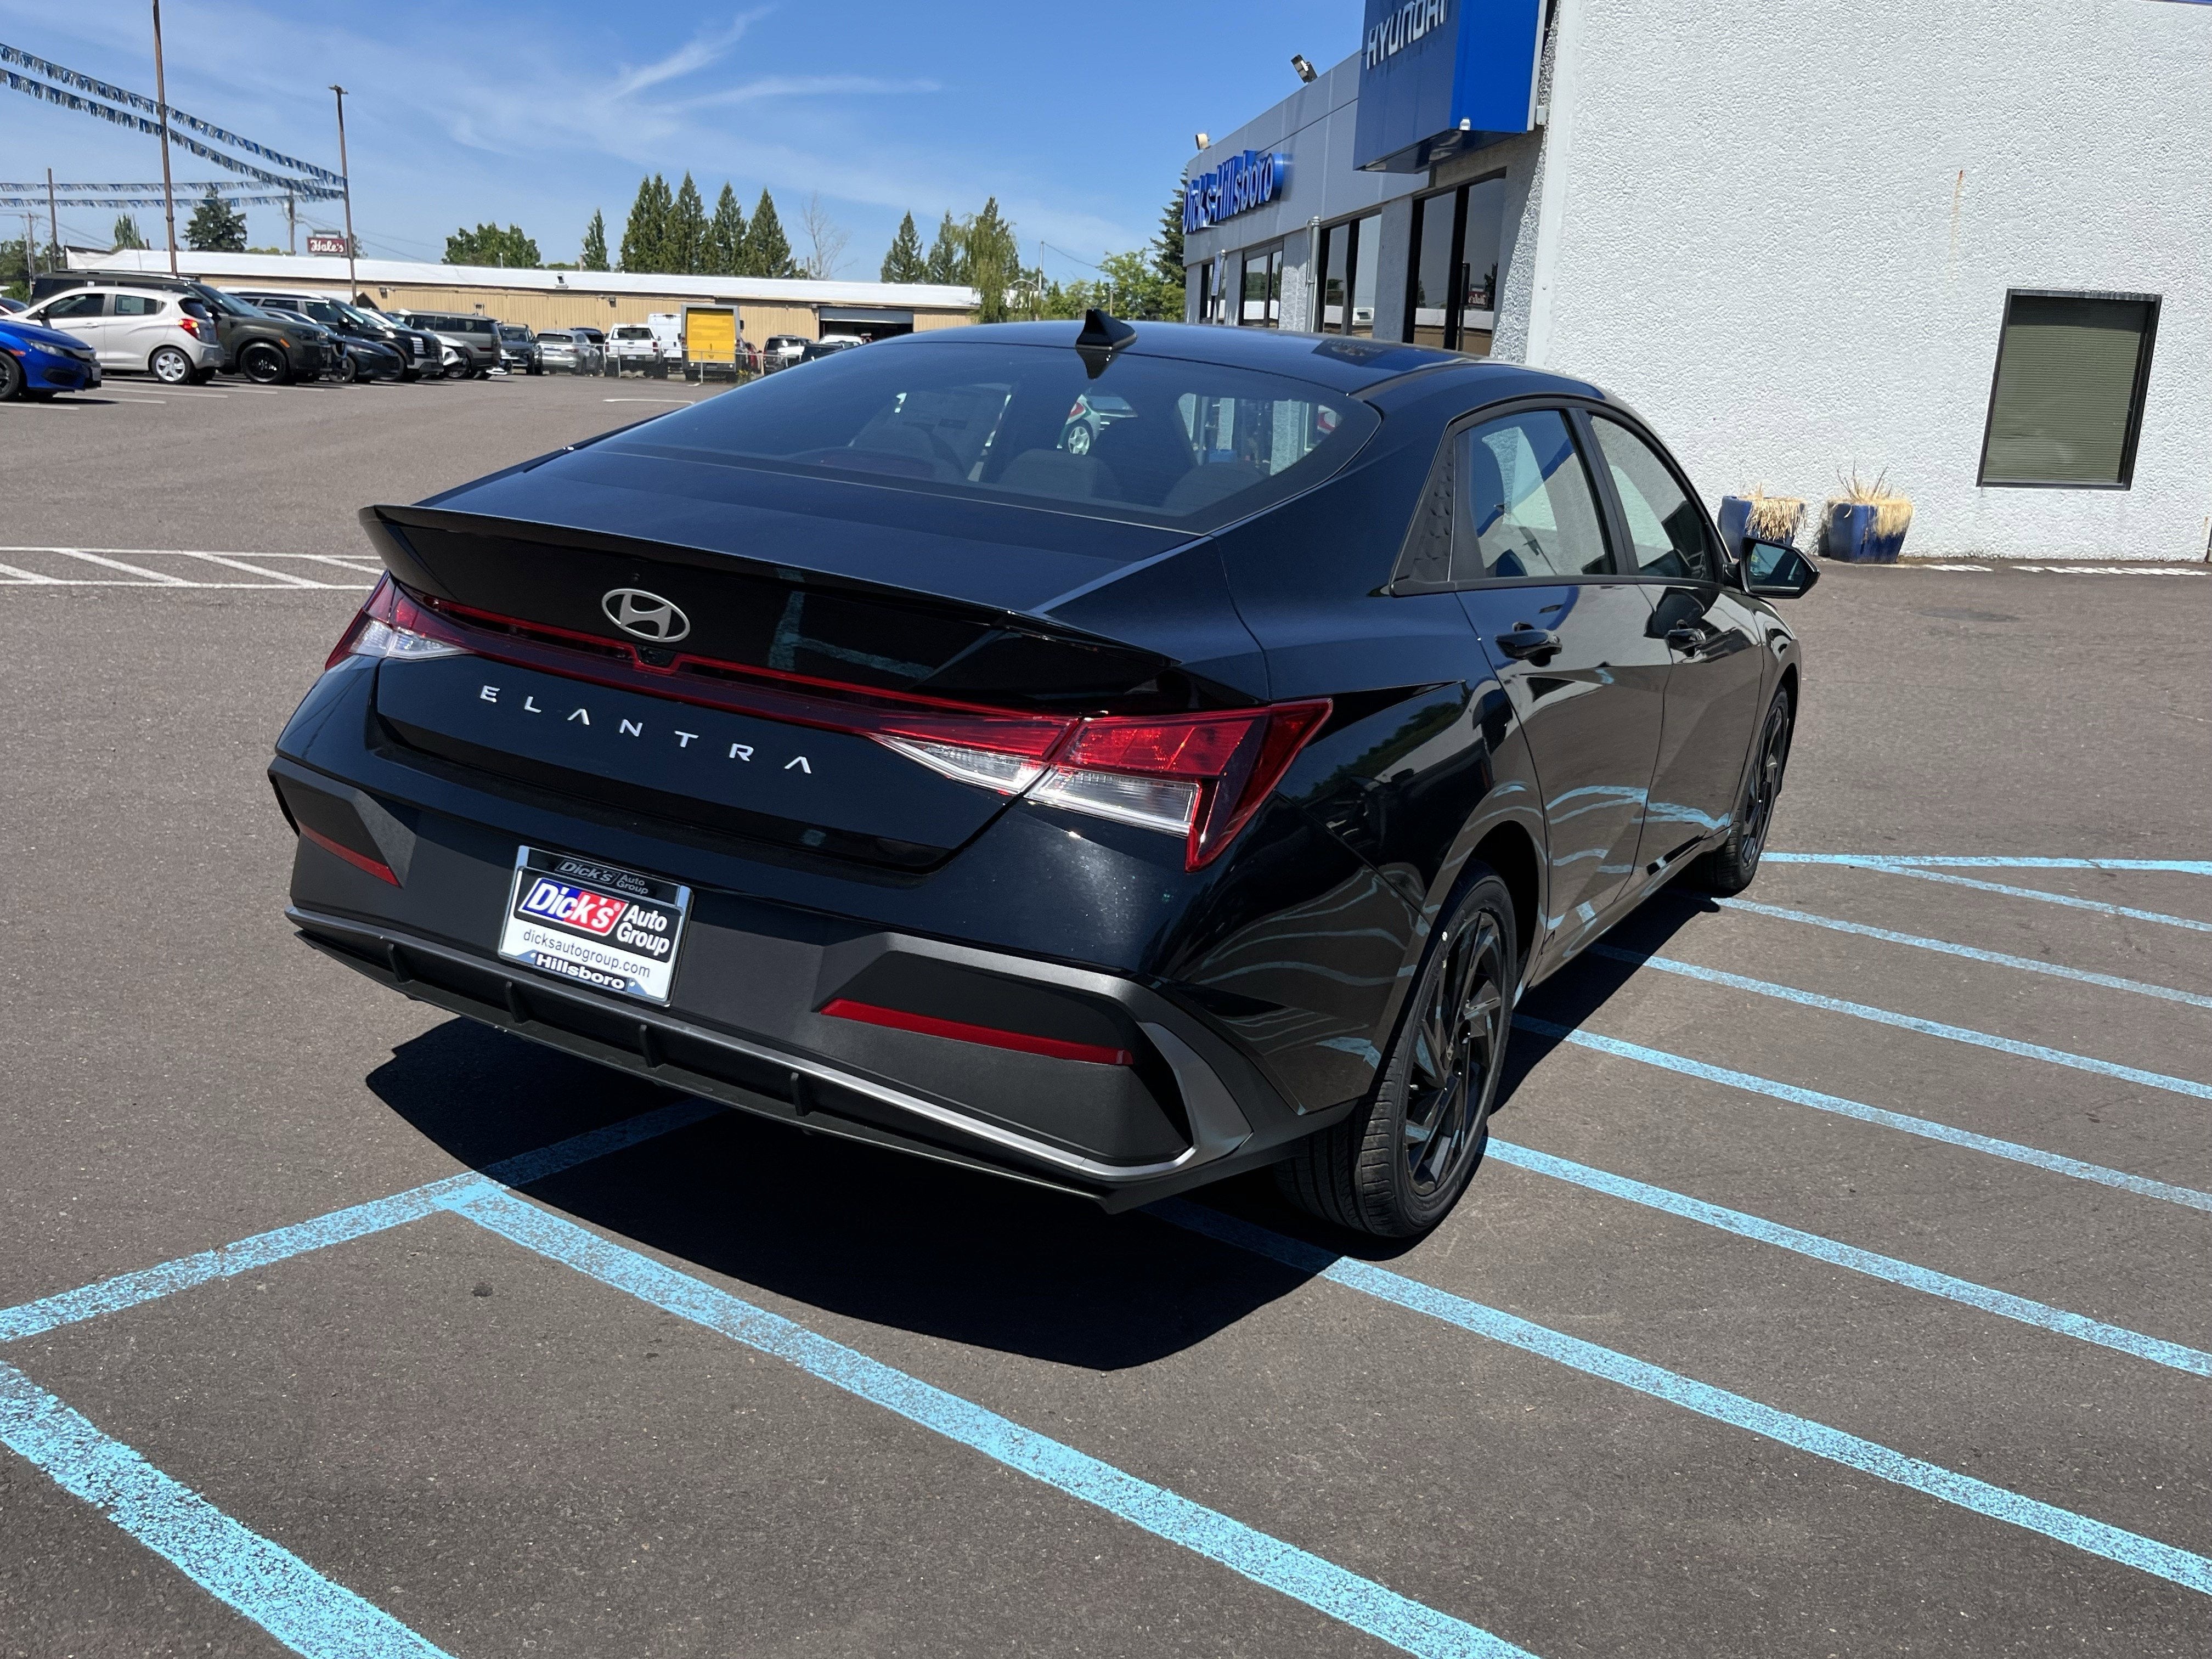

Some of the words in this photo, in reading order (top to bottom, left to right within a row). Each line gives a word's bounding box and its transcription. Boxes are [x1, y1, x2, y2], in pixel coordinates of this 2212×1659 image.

[1367, 0, 1444, 70] HYUNDAI
[1214, 151, 1276, 222] Hillsboro
[309, 239, 345, 253] Hale's
[479, 685, 812, 775] ELANTRA
[560, 861, 613, 882] Dick's
[619, 874, 645, 886] Auto
[616, 880, 648, 895] Group
[527, 882, 614, 929] Dick's
[623, 904, 668, 932] Auto
[523, 929, 651, 978] dicksautogroup.com
[616, 922, 670, 956] Group
[536, 953, 625, 990] Hillsboro
